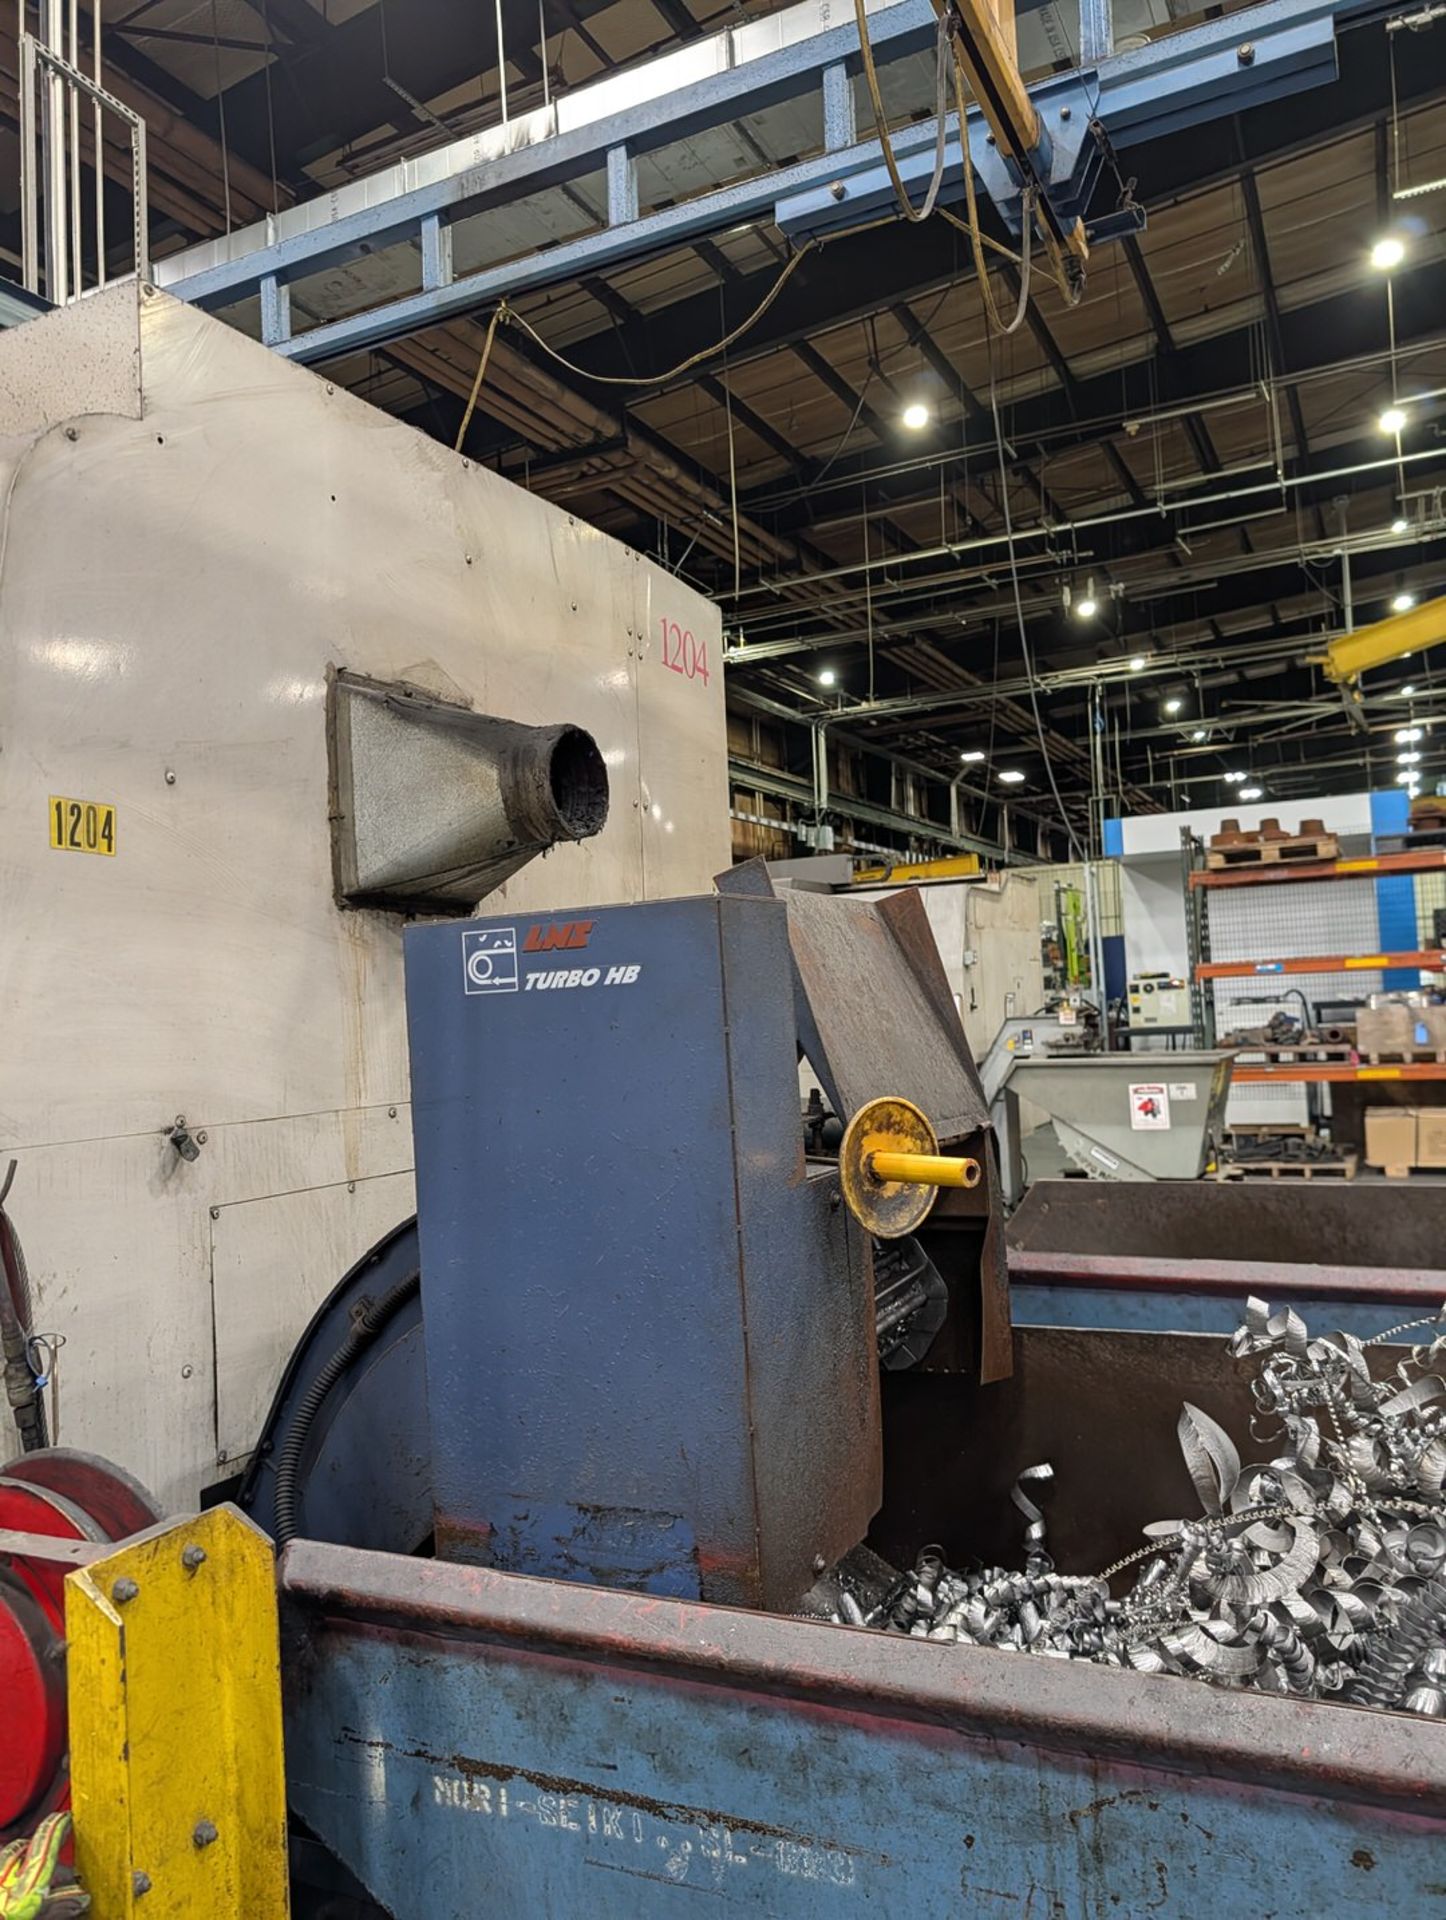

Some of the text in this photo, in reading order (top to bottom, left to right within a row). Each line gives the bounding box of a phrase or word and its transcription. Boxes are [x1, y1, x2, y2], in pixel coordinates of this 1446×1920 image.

[660, 617, 709, 687] 1204
[55, 800, 113, 853] 1204
[524, 964, 642, 992] TURBO HB
